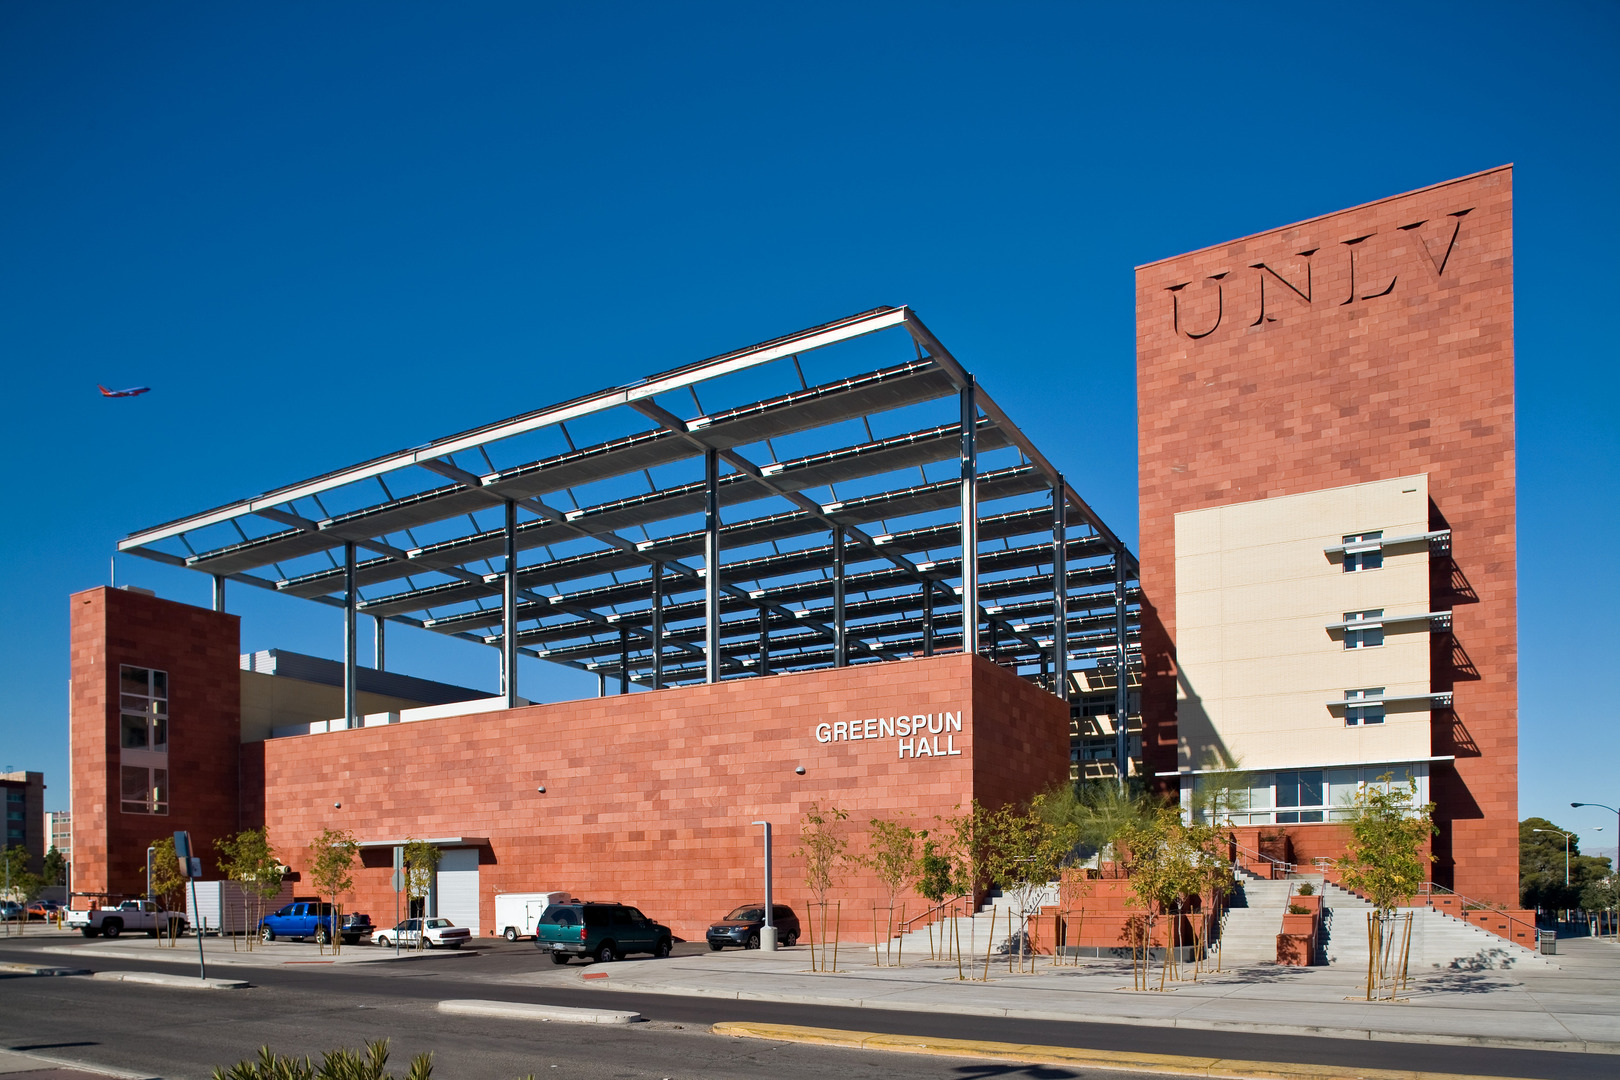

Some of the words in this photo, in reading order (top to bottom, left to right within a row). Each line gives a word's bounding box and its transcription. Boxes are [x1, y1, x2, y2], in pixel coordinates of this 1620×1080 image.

[1164, 207, 1476, 340] UNLV
[815, 711, 962, 743] GREENSPUN
[899, 735, 961, 759] HALL
